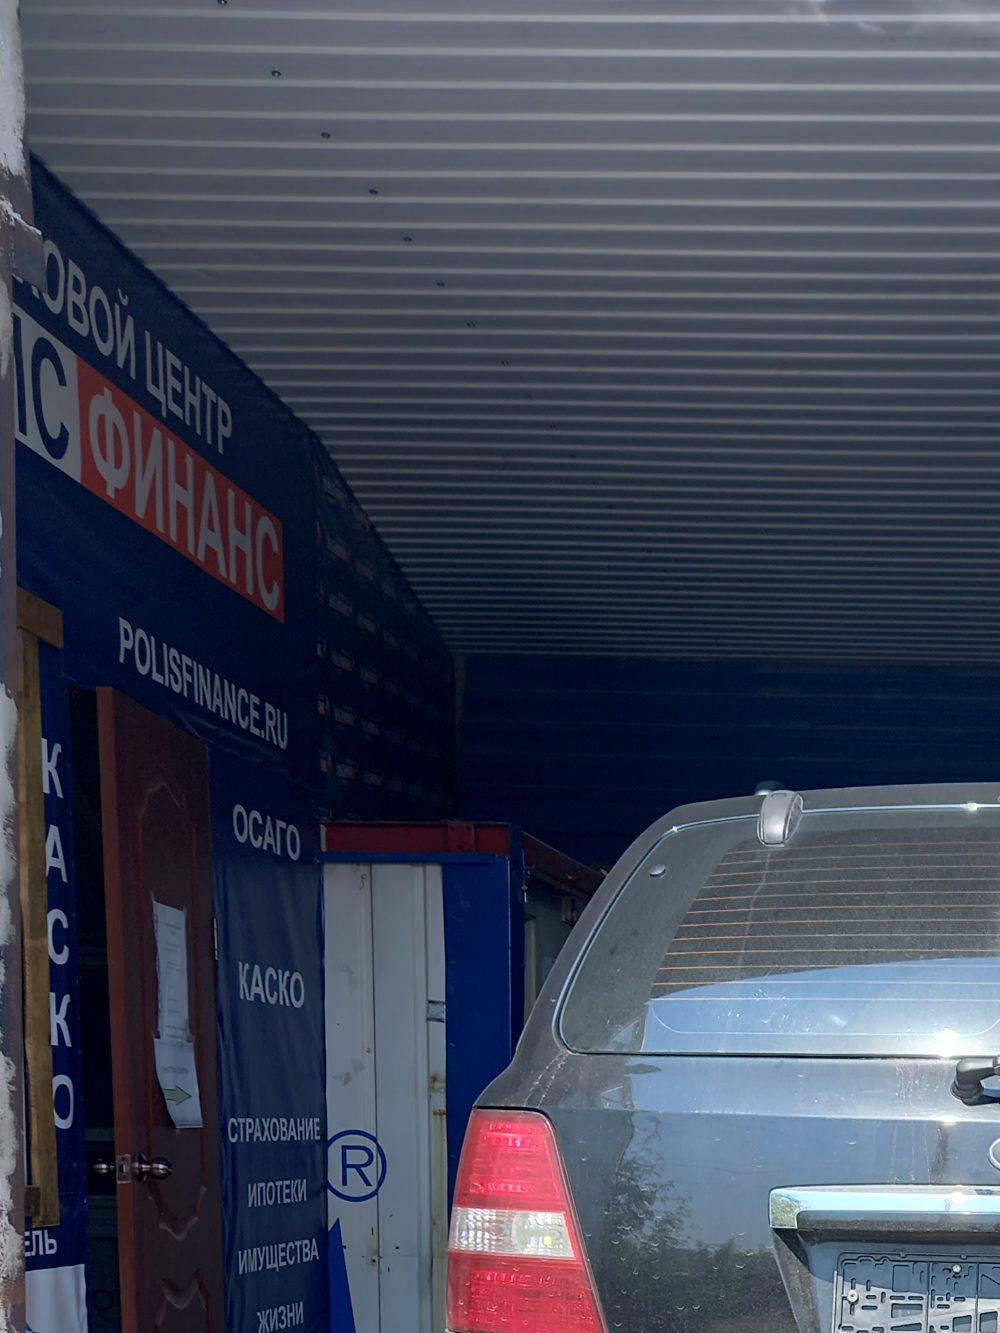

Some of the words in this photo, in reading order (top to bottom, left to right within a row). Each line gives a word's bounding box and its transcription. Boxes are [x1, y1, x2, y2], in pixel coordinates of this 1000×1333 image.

[145, 328, 233, 455] ЦЕНТР
[88, 386, 280, 613] ФИНАНС
[118, 616, 290, 750] POLISFINANCE.RU
[232, 804, 301, 861] ОСАГО
[238, 961, 305, 1009] КАСКО
[227, 1117, 321, 1143] СТРАХОВАНИЕ
[248, 1179, 307, 1208] ИПОТЕКИ
[238, 1238, 319, 1275] ИМУЩЕСТВА
